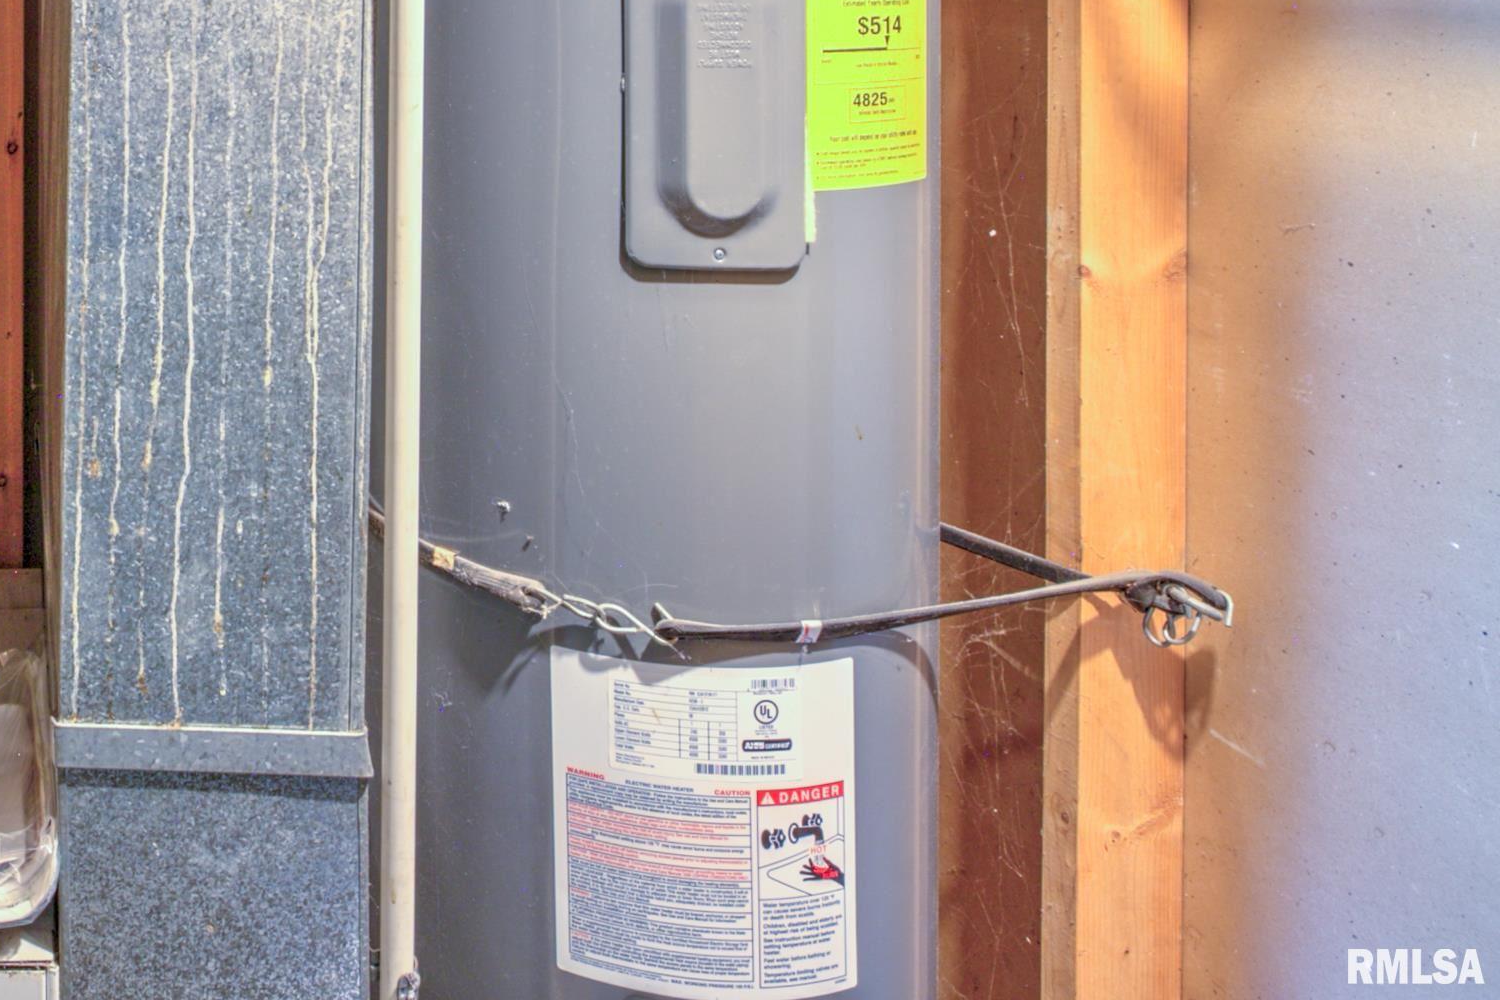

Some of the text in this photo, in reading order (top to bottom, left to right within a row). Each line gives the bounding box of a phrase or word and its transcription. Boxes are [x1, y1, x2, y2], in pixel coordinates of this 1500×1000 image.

[858, 15, 902, 36] $514
[853, 92, 888, 107] 4825
[567, 766, 604, 780] WARNING
[778, 784, 840, 804] DANGER
[810, 845, 827, 854] HOT
